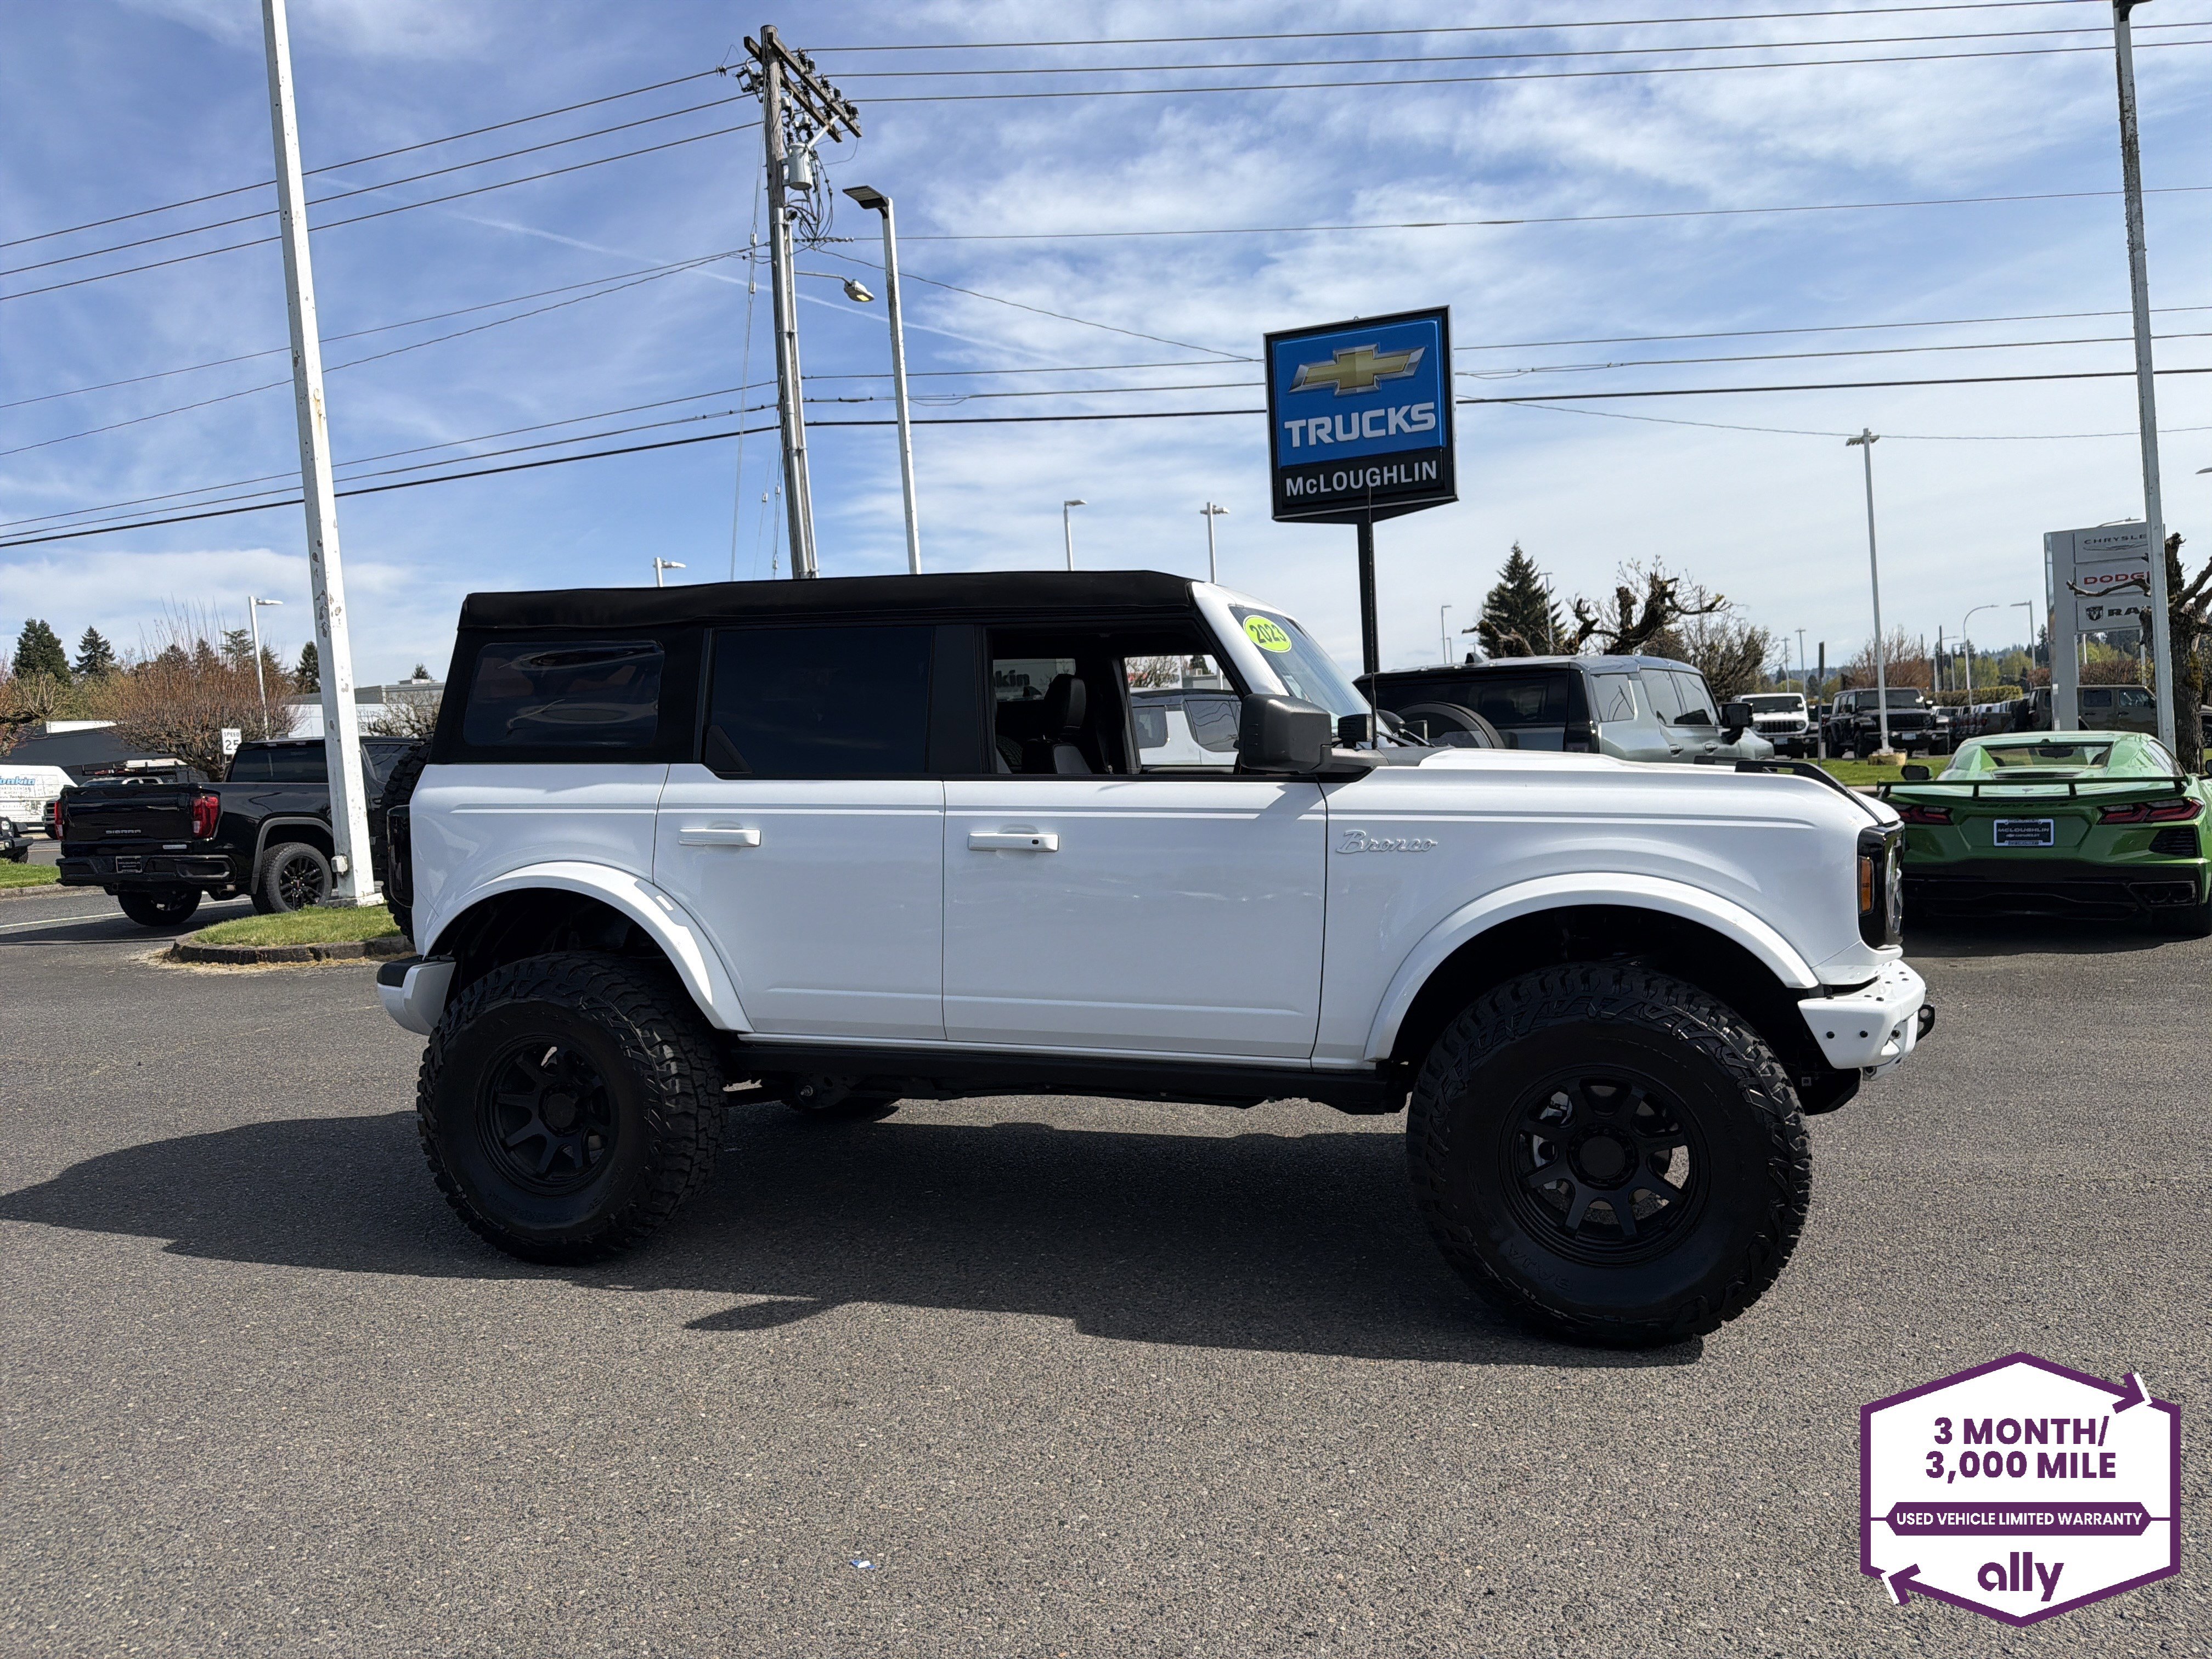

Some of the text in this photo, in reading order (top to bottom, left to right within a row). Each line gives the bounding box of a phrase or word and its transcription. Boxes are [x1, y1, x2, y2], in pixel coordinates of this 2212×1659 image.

[1284, 402, 1436, 448] TRUCKS
[1286, 460, 1437, 496] McLOUGHLIN
[2084, 533, 2147, 545] CHRYSLE
[2084, 571, 2149, 585] DODG
[2108, 607, 2142, 617] RA
[1249, 618, 1287, 644] 2023
[225, 739, 239, 751] 25
[1335, 829, 1438, 854] Bronco
